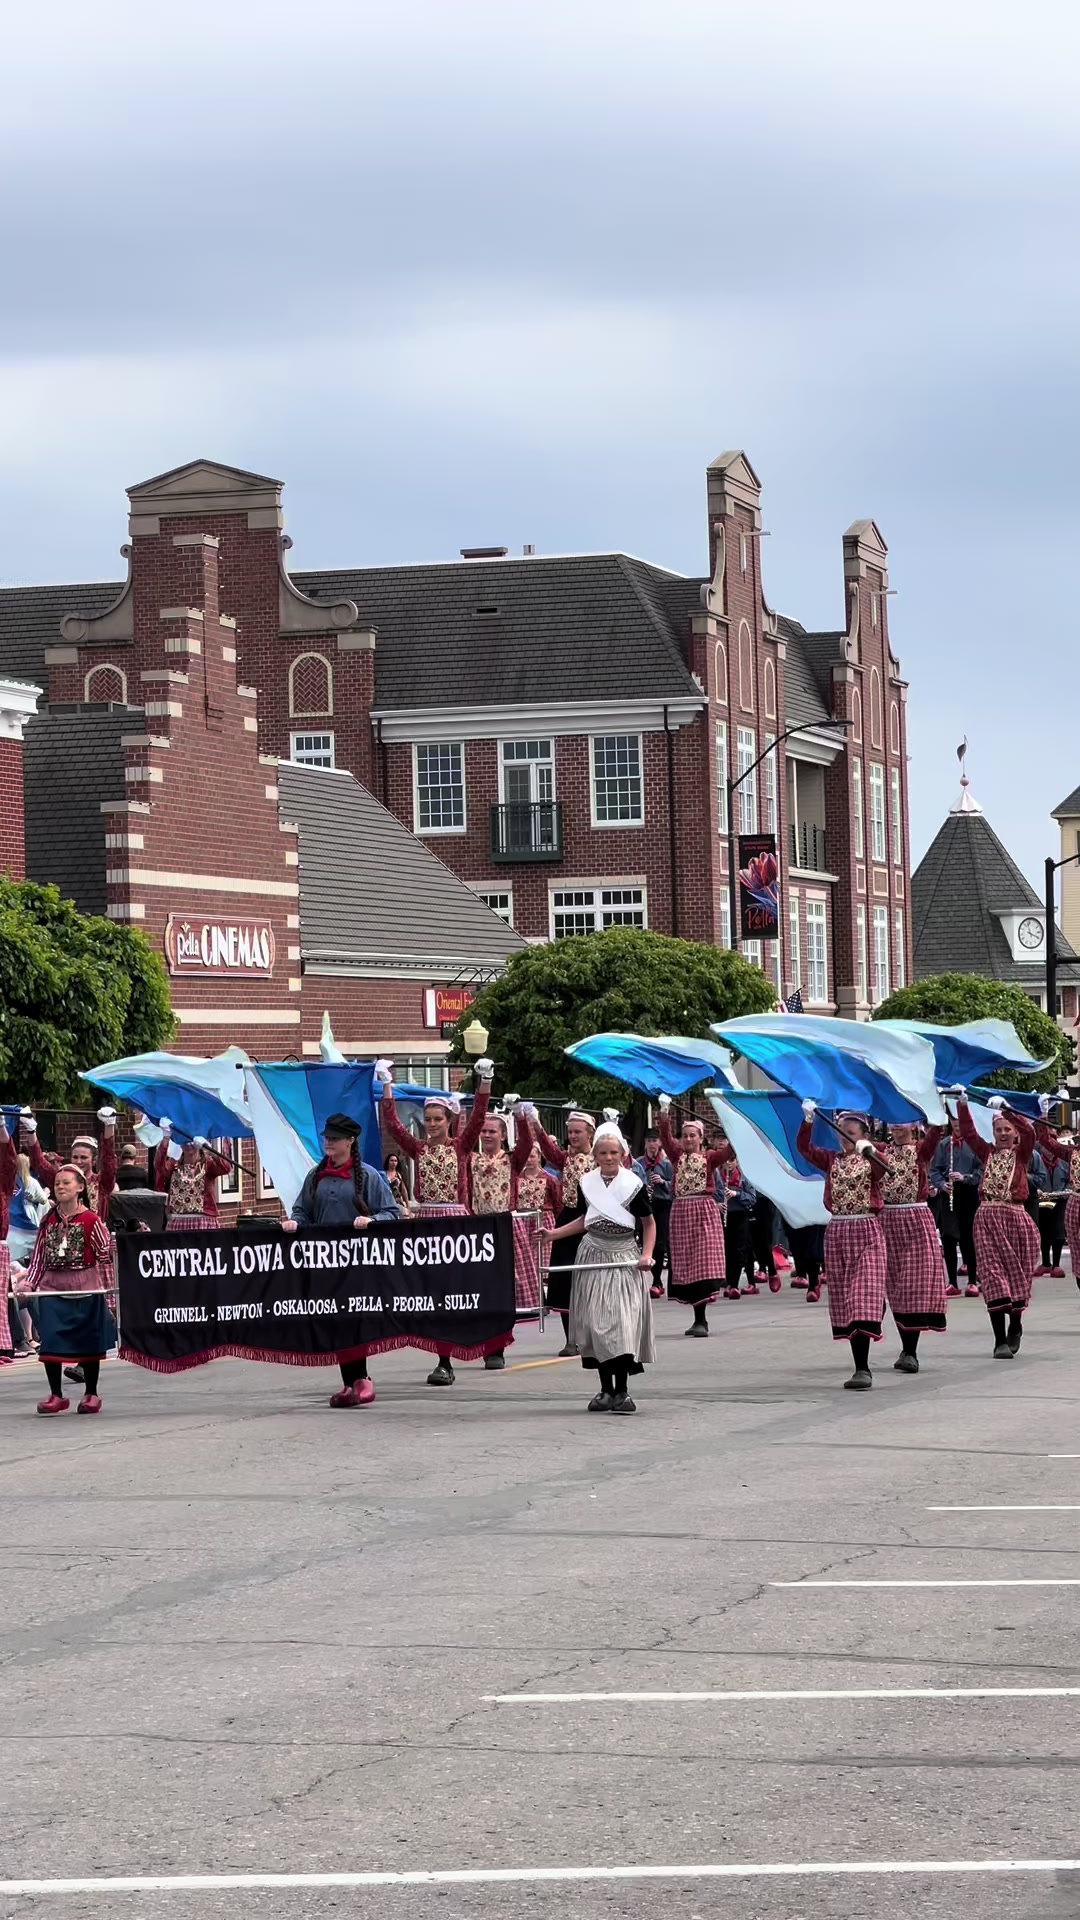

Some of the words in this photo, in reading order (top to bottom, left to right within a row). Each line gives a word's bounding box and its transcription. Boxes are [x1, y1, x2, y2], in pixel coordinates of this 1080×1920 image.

[201, 924, 270, 969] CINEMAS
[436, 991, 463, 1010] Oriental
[138, 1247, 228, 1279] CENTRAL
[232, 1242, 285, 1275] IOWA
[289, 1236, 396, 1269] CHRISTIAN
[402, 1232, 495, 1267] SCHOOLS
[154, 1306, 209, 1324] GRINNELL
[216, 1302, 264, 1322] NEWTON
[347, 1295, 384, 1313] PELLA
[392, 1295, 436, 1313] PEORIA
[444, 1293, 481, 1311] SULLY
